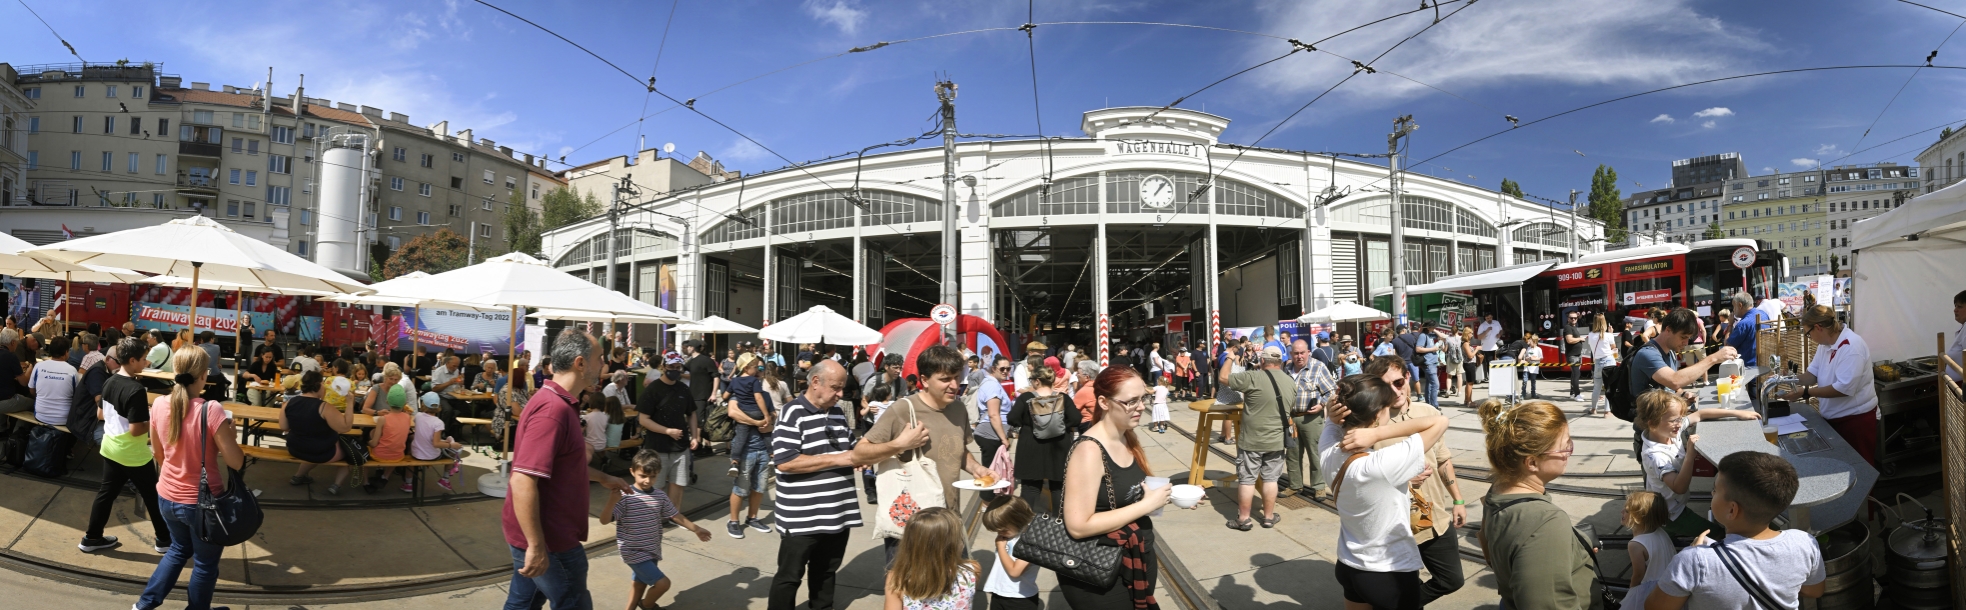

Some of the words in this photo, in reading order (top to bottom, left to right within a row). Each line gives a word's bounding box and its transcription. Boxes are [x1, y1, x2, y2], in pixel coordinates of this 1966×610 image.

[1117, 143, 1189, 155] WAGENHALLE
[1194, 146, 1199, 157] I
[1042, 216, 1048, 224] 5
[1156, 214, 1162, 222] 6
[906, 224, 911, 232] 4
[808, 232, 813, 240] 3
[1624, 262, 1668, 272] FAHRSIMULATOR
[449, 310, 493, 321] Tramway-Tag
[452, 336, 469, 345] 2022
